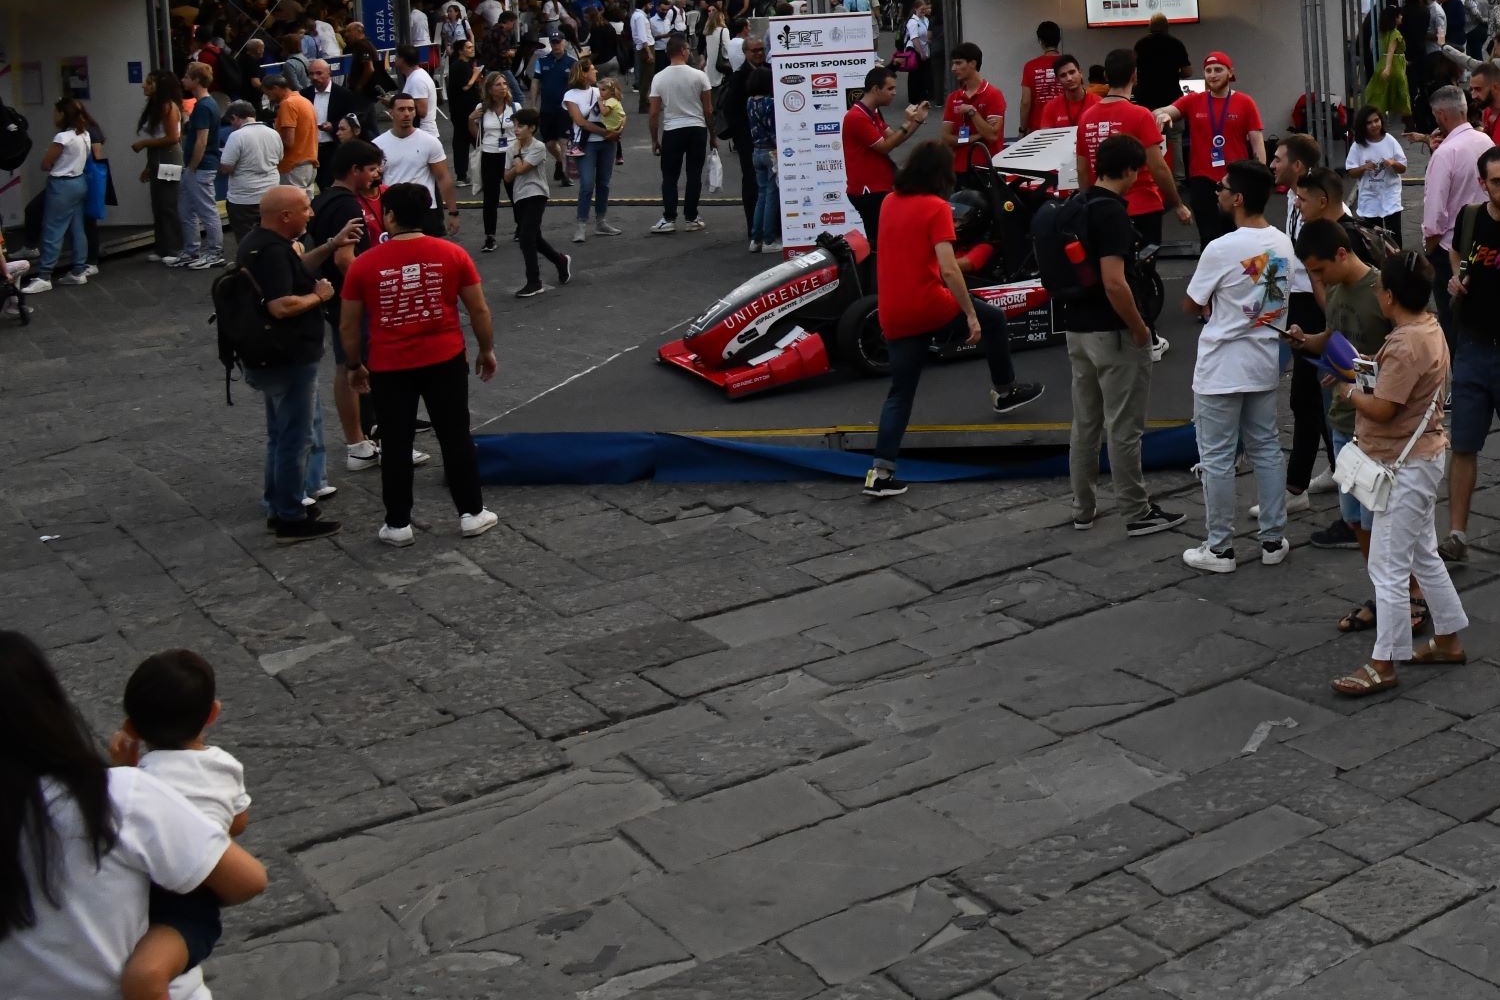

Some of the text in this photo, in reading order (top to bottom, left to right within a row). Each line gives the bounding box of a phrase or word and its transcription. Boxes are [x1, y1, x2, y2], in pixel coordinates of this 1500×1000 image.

[376, 9, 386, 42] AREA
[785, 61, 819, 69] NOSTRI
[820, 58, 867, 68] SPONSOR
[816, 123, 839, 131] SKF
[723, 276, 820, 329] UNIFIRENZE
